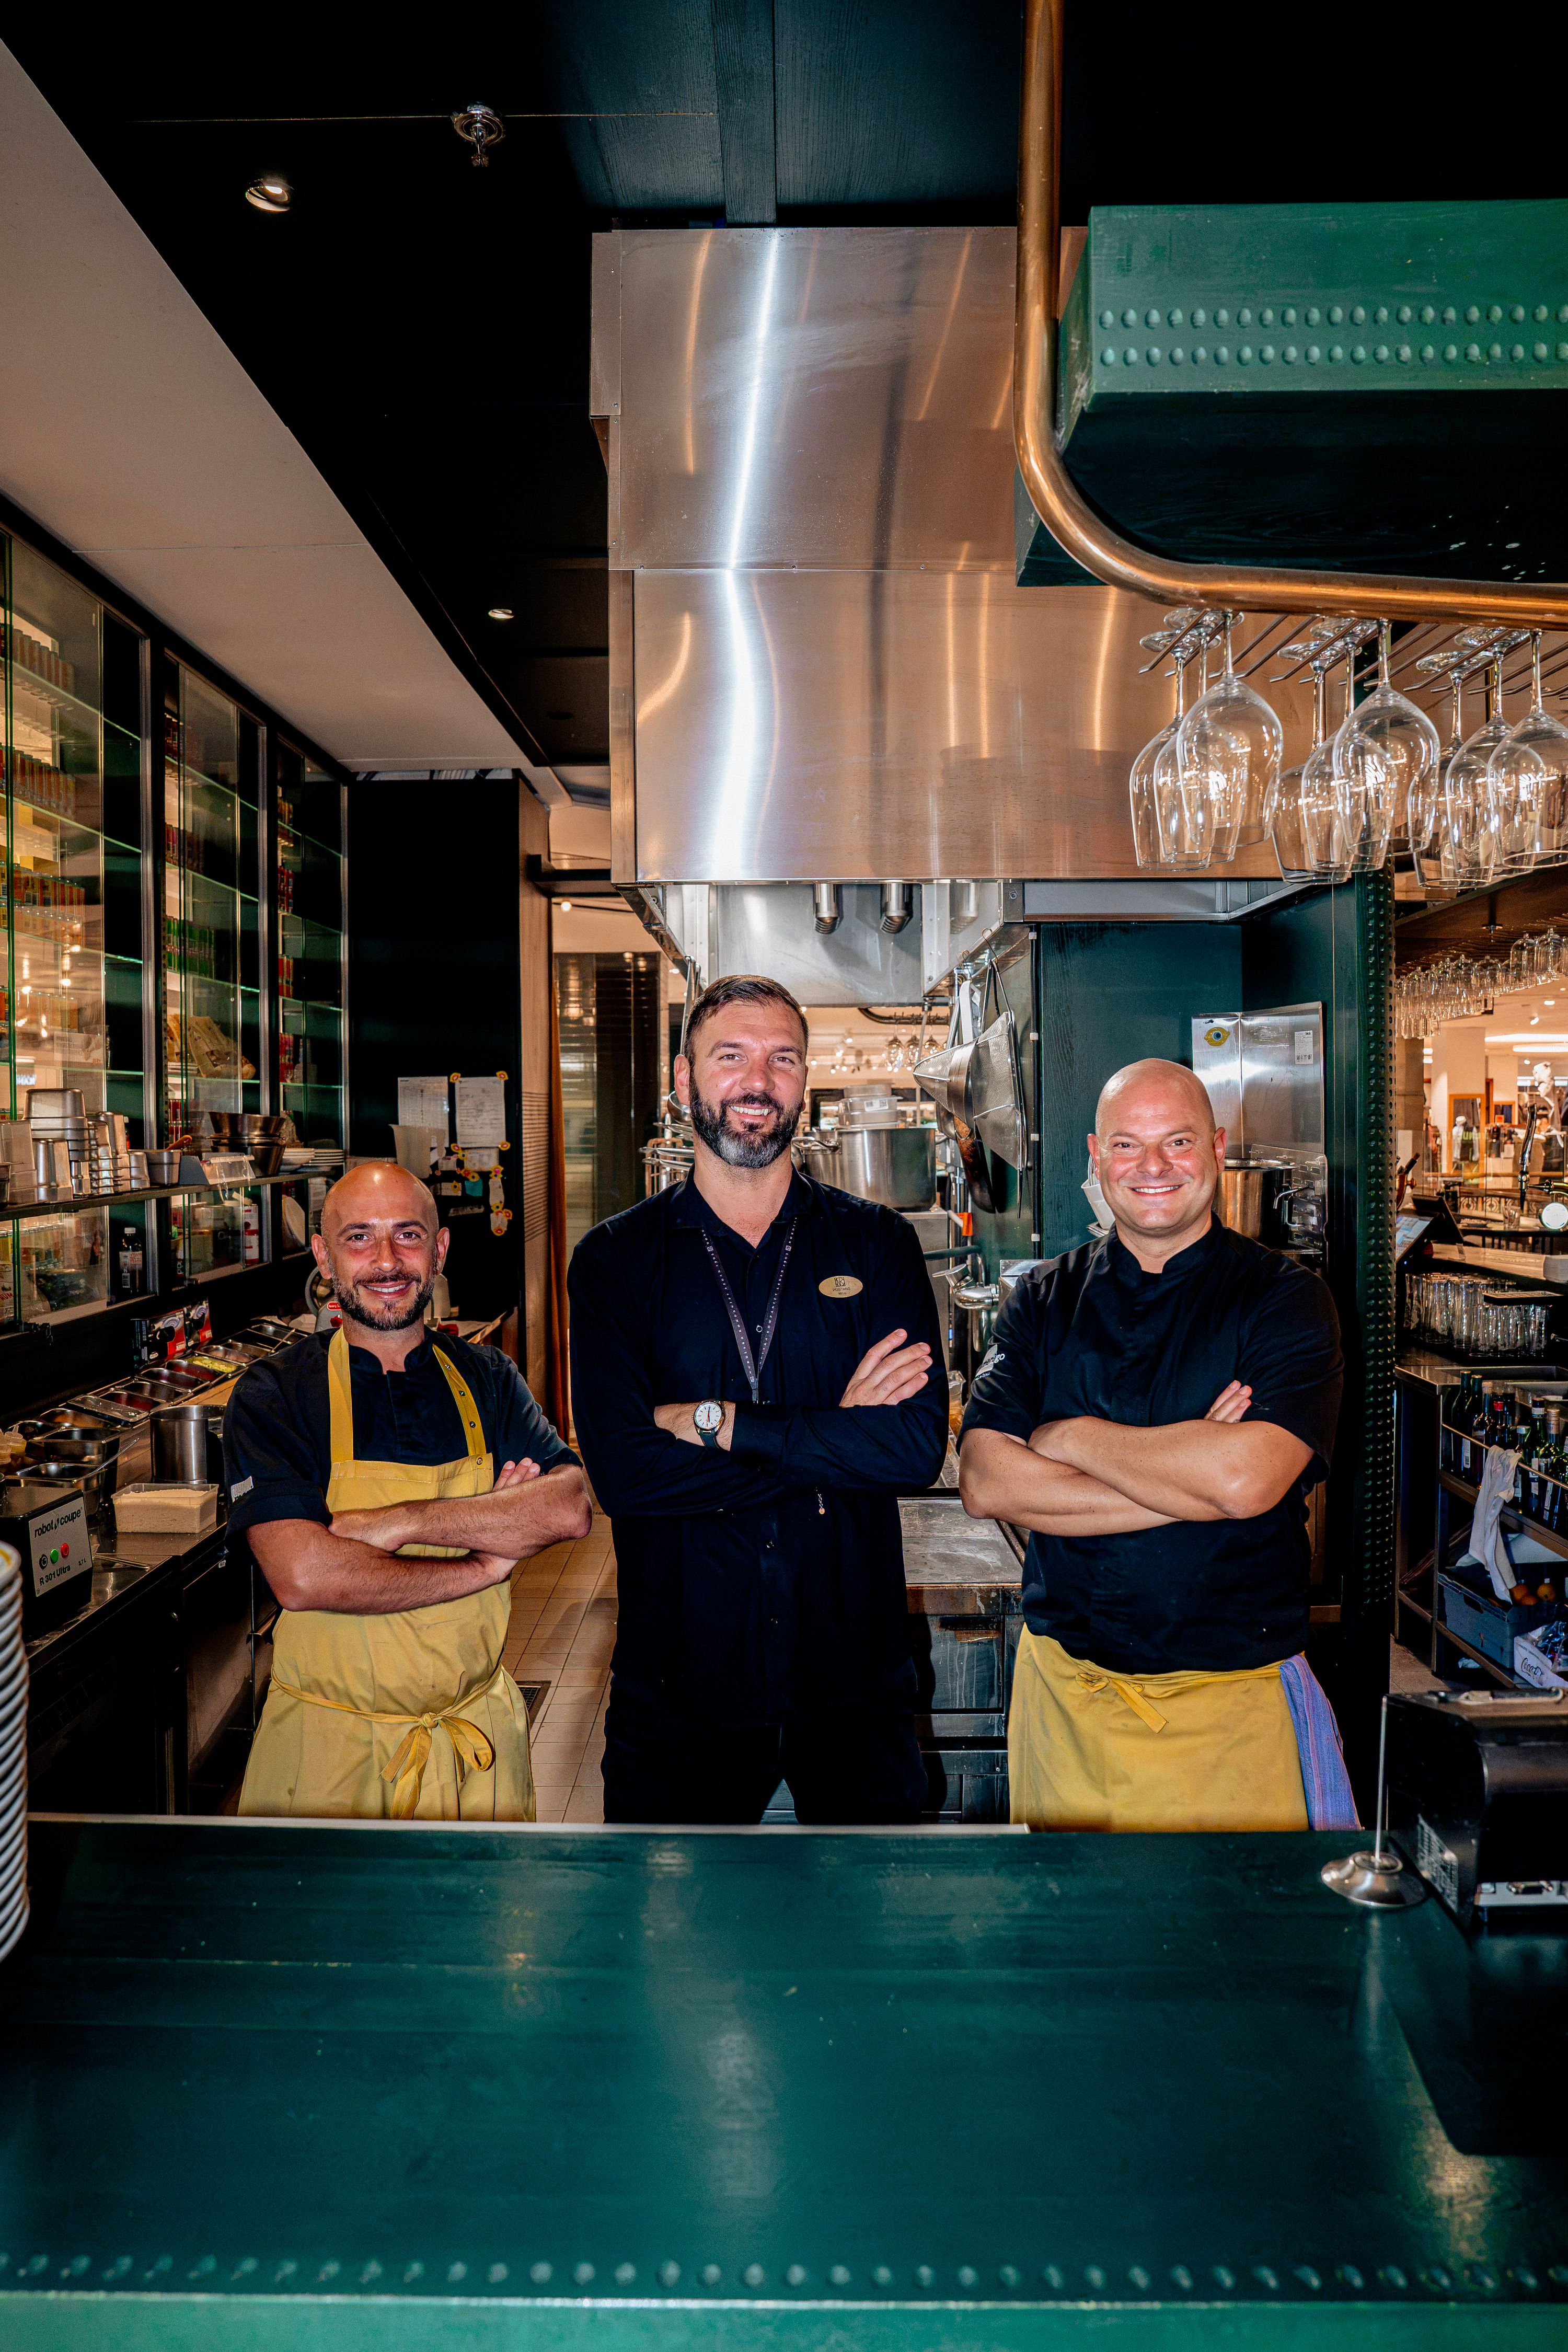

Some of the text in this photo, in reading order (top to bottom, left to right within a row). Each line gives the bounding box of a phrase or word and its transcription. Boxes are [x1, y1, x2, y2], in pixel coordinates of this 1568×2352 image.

[34, 1509, 82, 1538] robot coupe
[39, 1564, 71, 1586] R 301 Ultra
